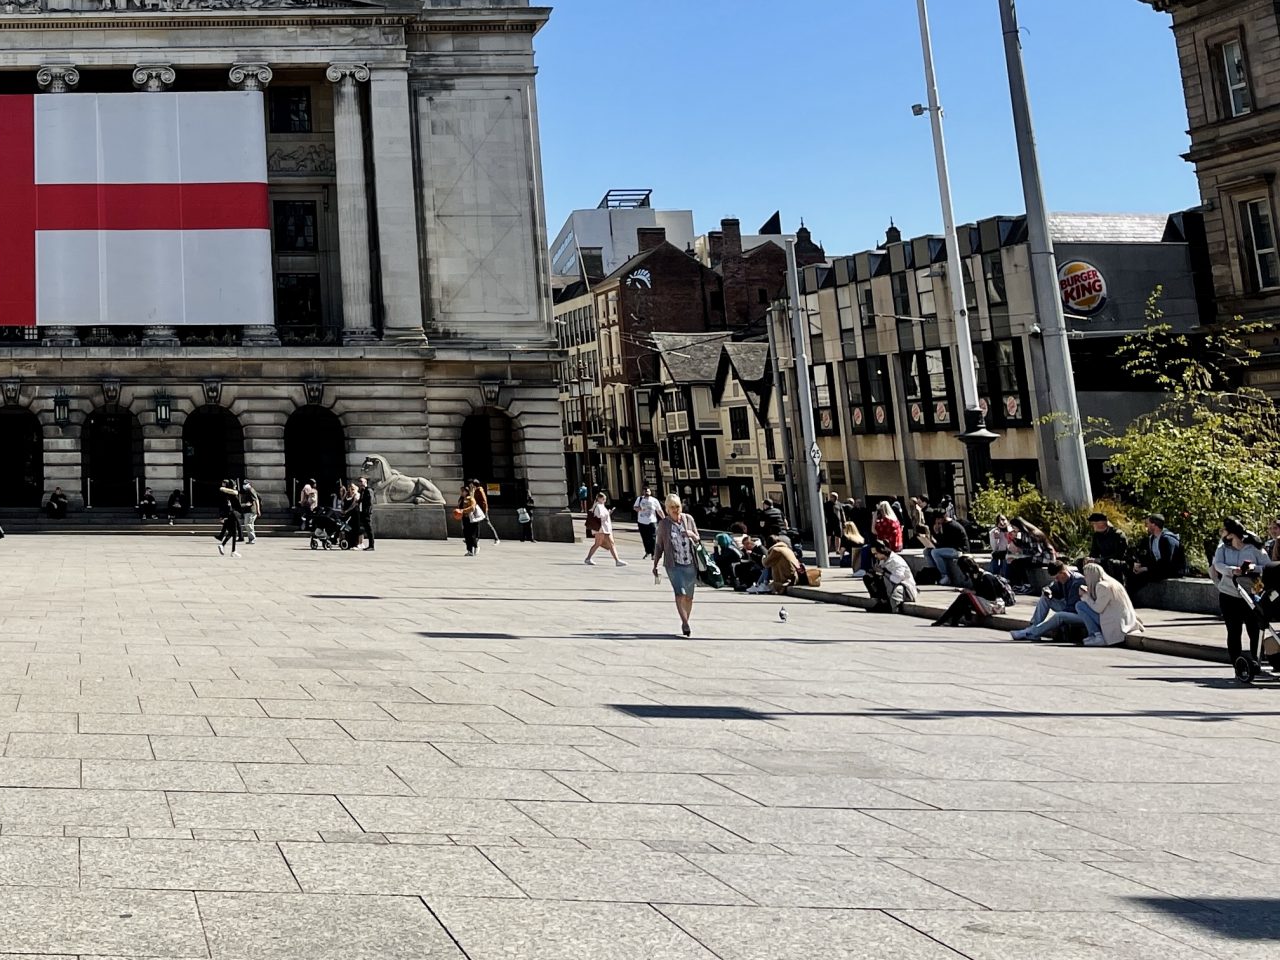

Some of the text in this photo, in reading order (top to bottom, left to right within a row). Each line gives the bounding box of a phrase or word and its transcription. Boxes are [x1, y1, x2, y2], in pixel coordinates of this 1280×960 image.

[1060, 270, 1099, 290] BURGER
[1064, 279, 1103, 304] KING
[811, 449, 821, 458] 25
